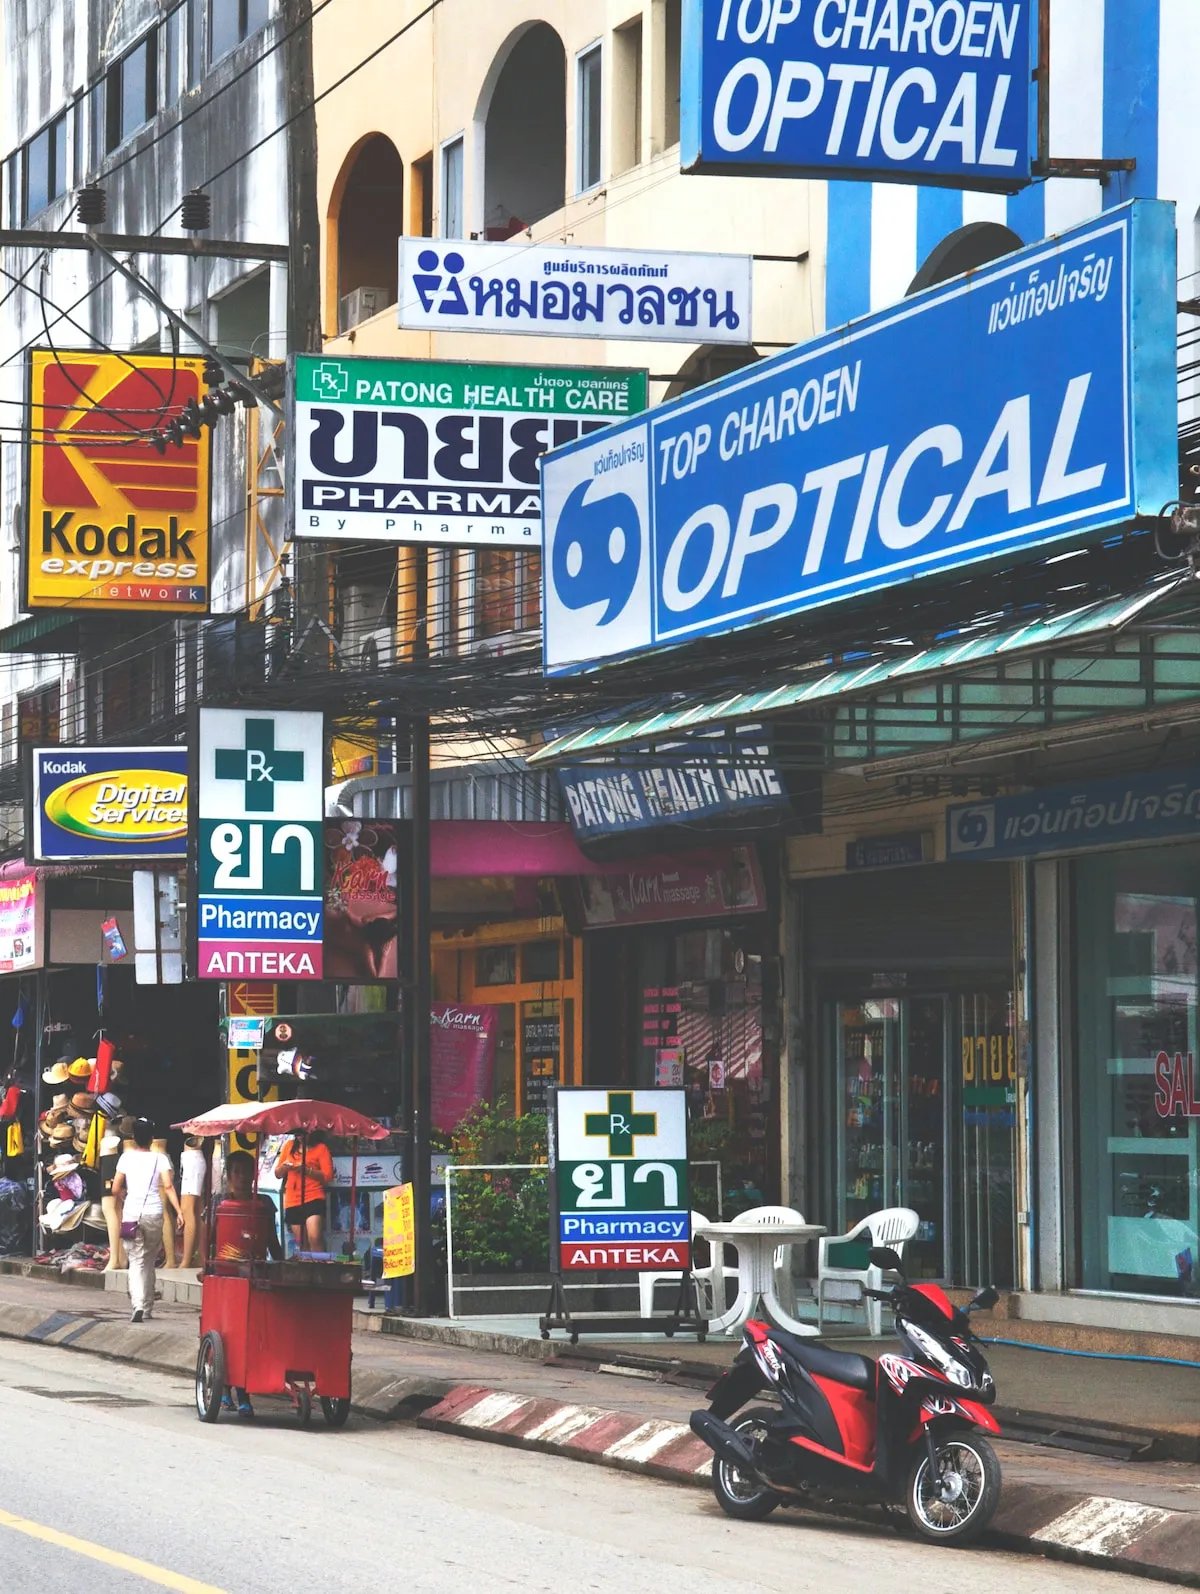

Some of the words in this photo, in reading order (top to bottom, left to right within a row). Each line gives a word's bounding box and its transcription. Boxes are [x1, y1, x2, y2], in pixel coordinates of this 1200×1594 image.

[716, 0, 799, 44] TOP
[813, 0, 1020, 59] CHAROEN
[713, 57, 1018, 167] OPTICAL
[469, 274, 741, 331] หมอมวลชน
[987, 255, 1114, 336] แว่นท็อปเจริญ
[356, 379, 453, 405] PATONG
[464, 384, 555, 409] HEALTH
[566, 389, 630, 412] CARE
[534, 372, 574, 388] ป่าตอง
[659, 432, 712, 487] TOP
[719, 360, 862, 463] CHAROEN
[310, 408, 614, 485] ขายย
[593, 441, 646, 479] แว่นท็อปเจริญ
[312, 486, 542, 516] PHARMA
[661, 372, 1109, 613] OPTICAL
[41, 511, 197, 561] Kodak
[309, 515, 347, 531] By
[385, 520, 533, 537] Pharma
[40, 558, 200, 579] express
[93, 586, 198, 600] network
[43, 760, 88, 775] Kodak
[96, 783, 187, 808] Digital
[565, 773, 644, 830] PATONG
[638, 757, 721, 819] HEALTH
[717, 757, 783, 801] CARE
[209, 822, 315, 892] ยา
[331, 863, 389, 891] Karn
[201, 904, 320, 935] Pharmacy
[442, 1006, 481, 1025] Karn
[571, 1162, 679, 1208] ยา
[564, 1218, 685, 1238] Pharmacy
